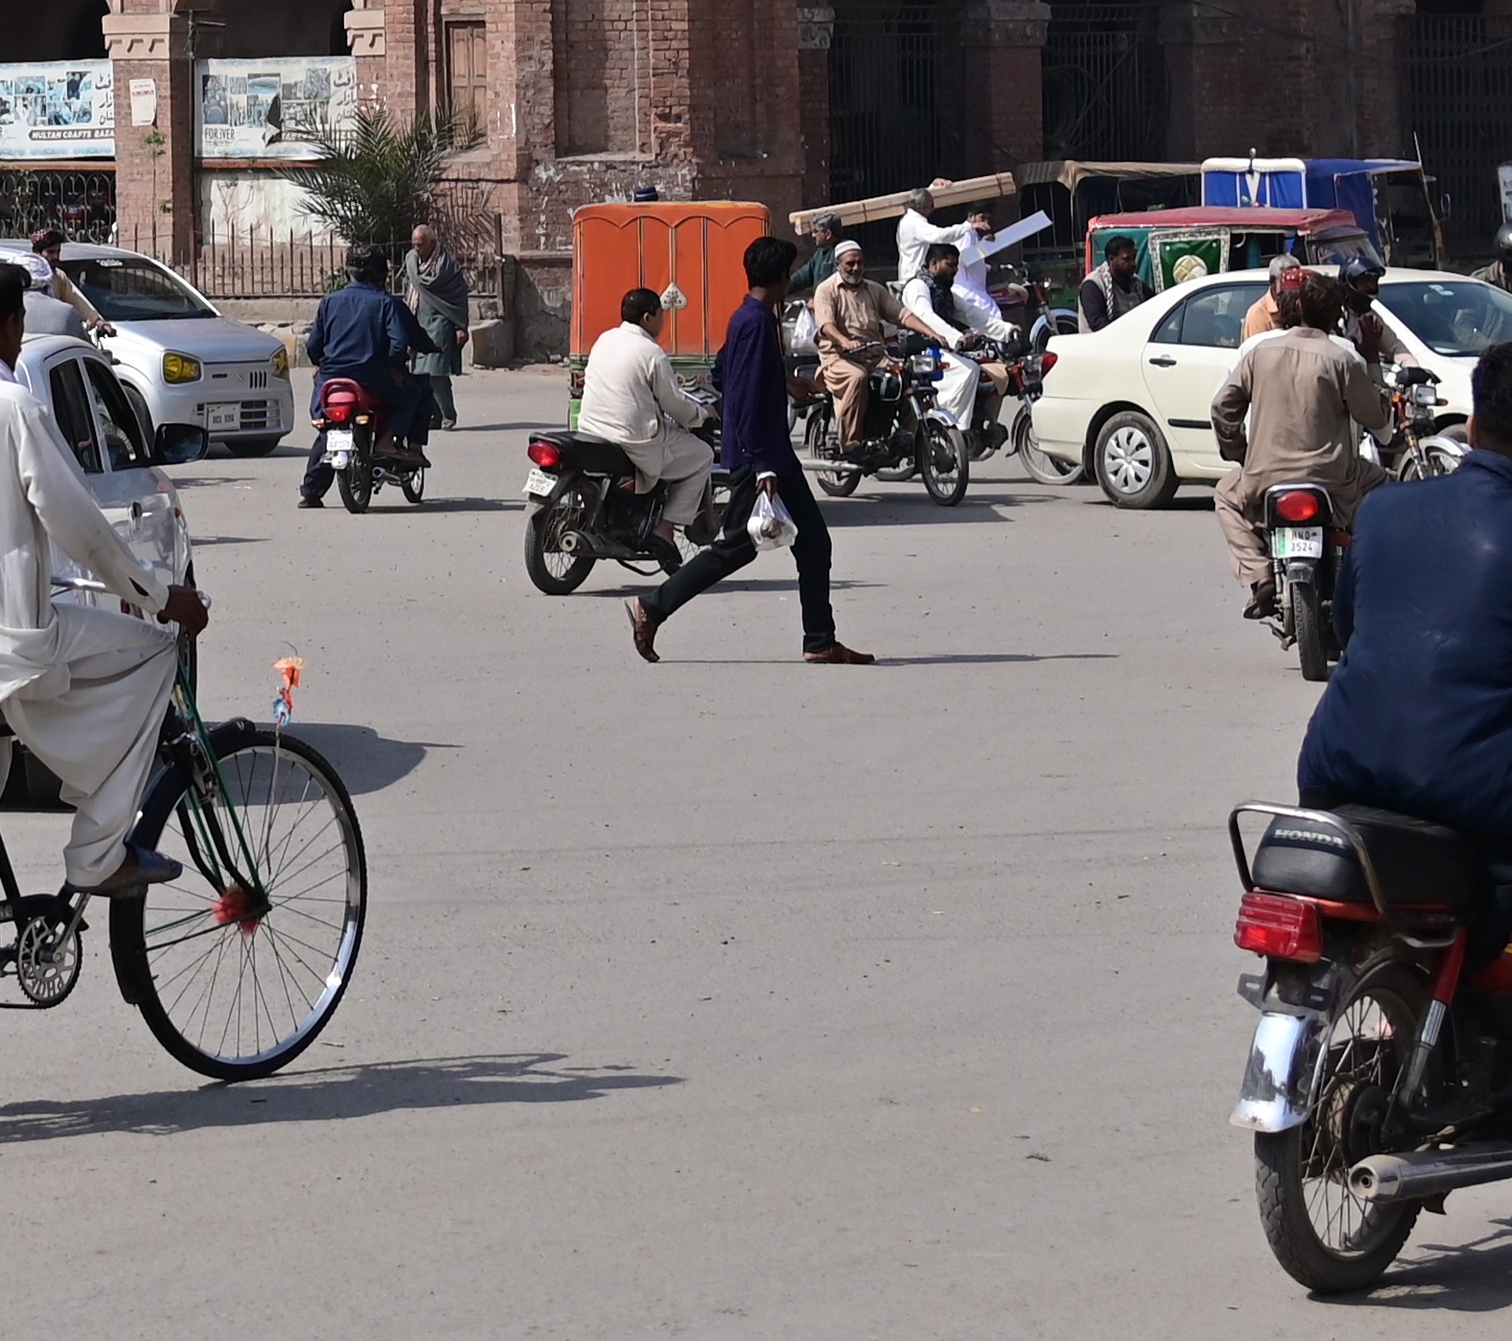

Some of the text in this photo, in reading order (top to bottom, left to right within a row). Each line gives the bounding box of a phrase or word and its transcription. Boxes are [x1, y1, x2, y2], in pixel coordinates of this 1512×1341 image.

[31, 131, 62, 140] MULTAN
[63, 130, 92, 139] CRAFTS
[1275, 828, 1346, 849] HONDA
